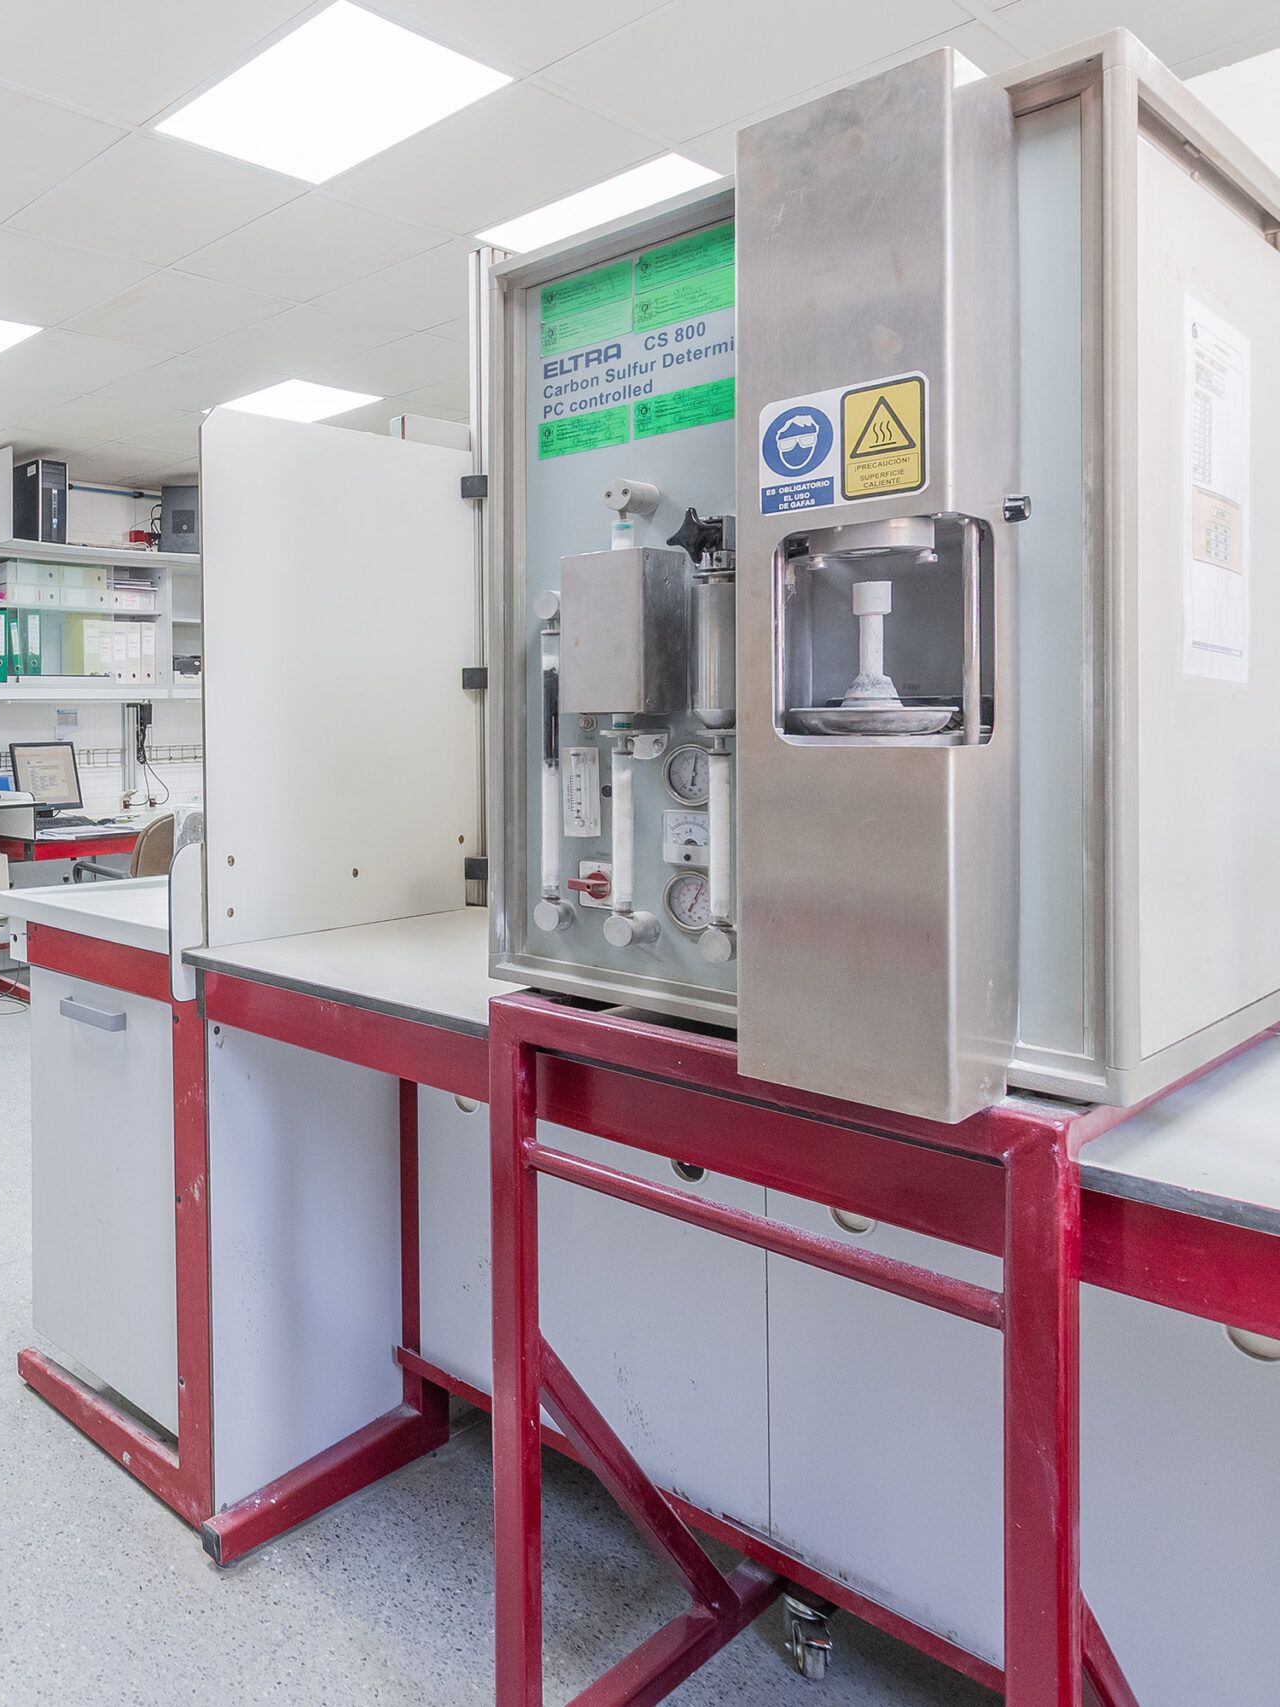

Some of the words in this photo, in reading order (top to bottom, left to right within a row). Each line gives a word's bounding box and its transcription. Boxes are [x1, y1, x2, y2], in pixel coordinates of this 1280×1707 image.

[644, 332, 668, 351] CS
[674, 321, 706, 343] 800
[543, 343, 622, 380] ELTRA
[543, 376, 600, 399] Carbon
[605, 359, 657, 383] Sulfur
[543, 401, 564, 419] PC
[570, 378, 653, 413] controlled
[859, 468, 905, 481] SUPERFICIE
[778, 480, 830, 494] OBLIGATORIO
[863, 476, 901, 488] CALIENTE
[790, 498, 816, 508] GAFAS
[794, 492, 810, 500] USO
